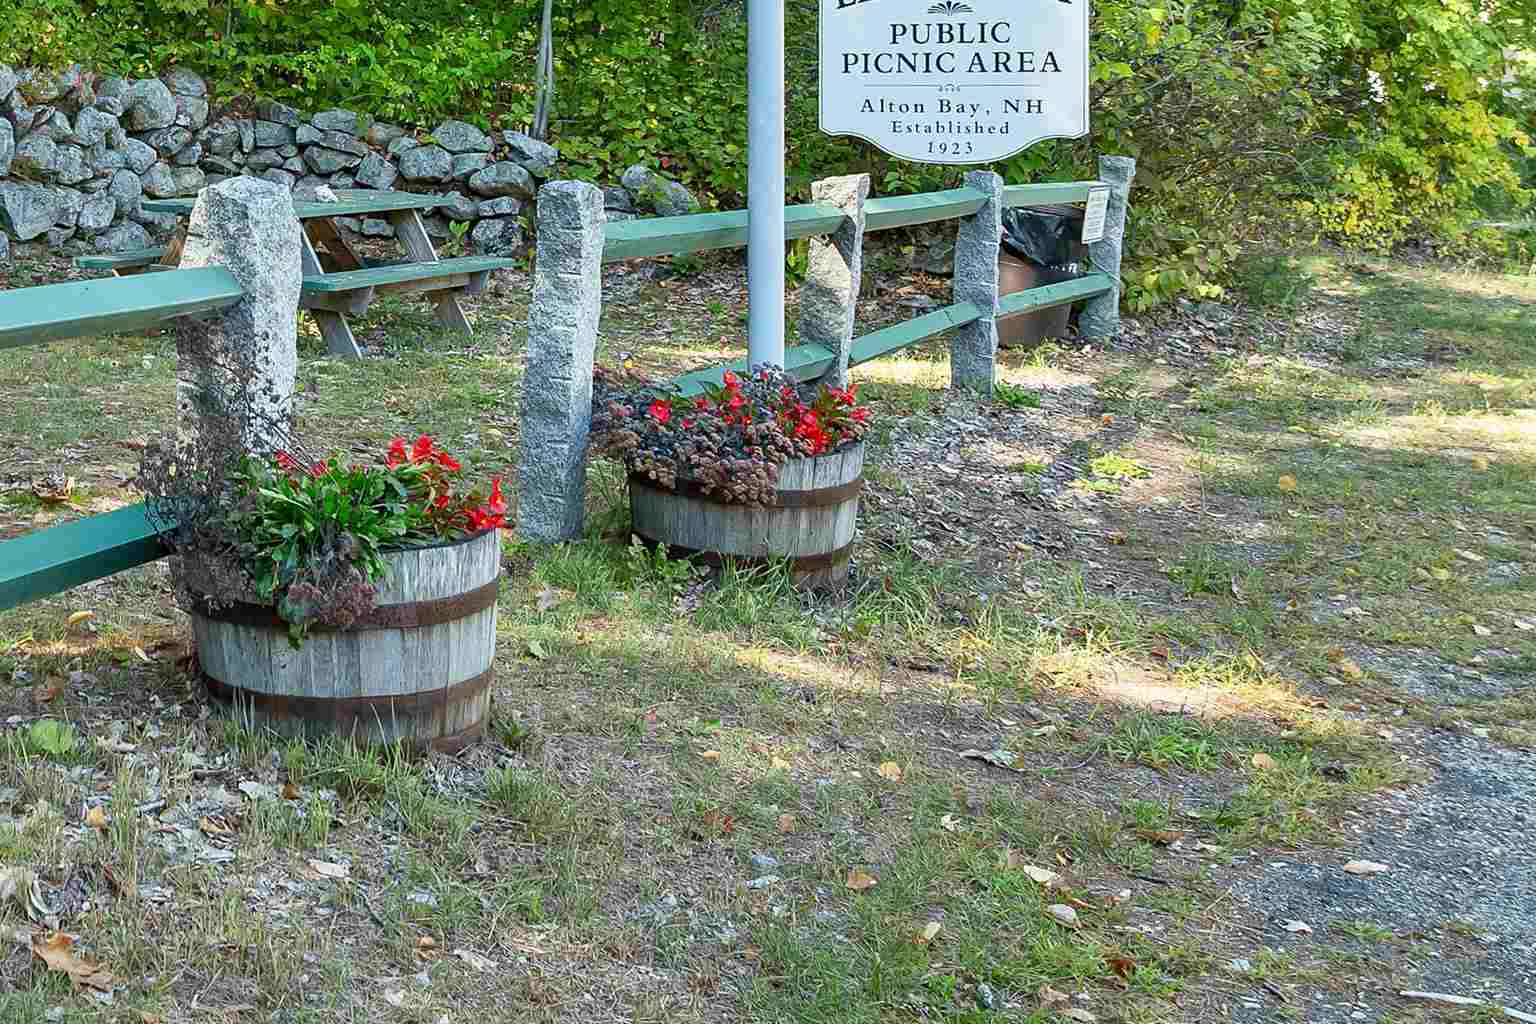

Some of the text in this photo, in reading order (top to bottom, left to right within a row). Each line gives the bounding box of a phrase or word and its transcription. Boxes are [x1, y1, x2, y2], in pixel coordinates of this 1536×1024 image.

[889, 22, 1011, 44] PUBLIC
[841, 51, 1062, 74] PICNIC AREA
[860, 98, 1044, 118] Alton Bay, NH
[890, 120, 1010, 134] Established
[927, 142, 974, 155] 1923
